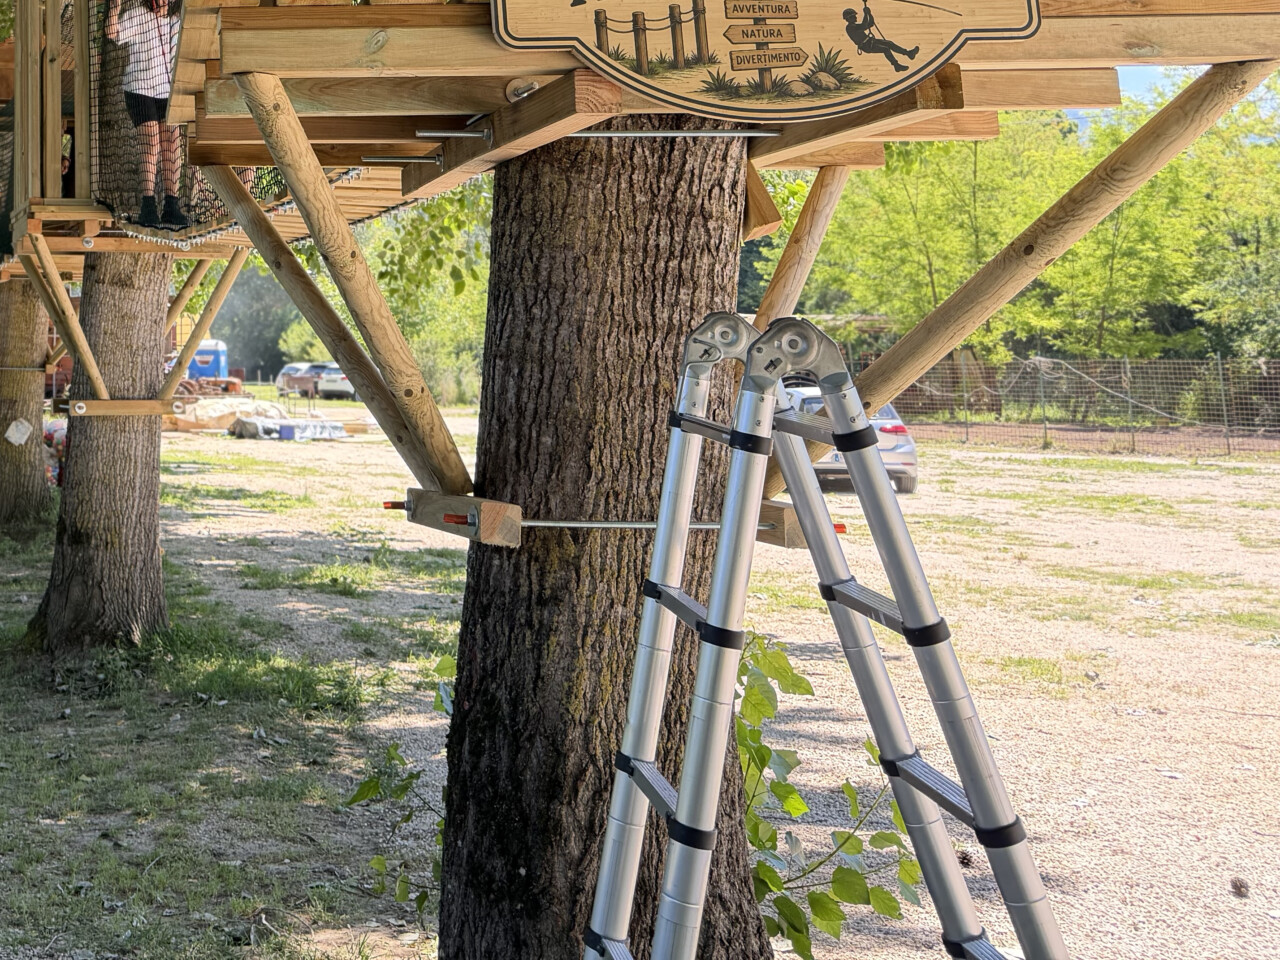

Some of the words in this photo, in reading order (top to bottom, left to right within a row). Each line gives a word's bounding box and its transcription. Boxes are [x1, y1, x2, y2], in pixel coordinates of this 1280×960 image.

[732, 3, 791, 14] AVVENTURA
[741, 28, 783, 39] NATURA
[736, 52, 801, 65] DIVERTIMENTO
